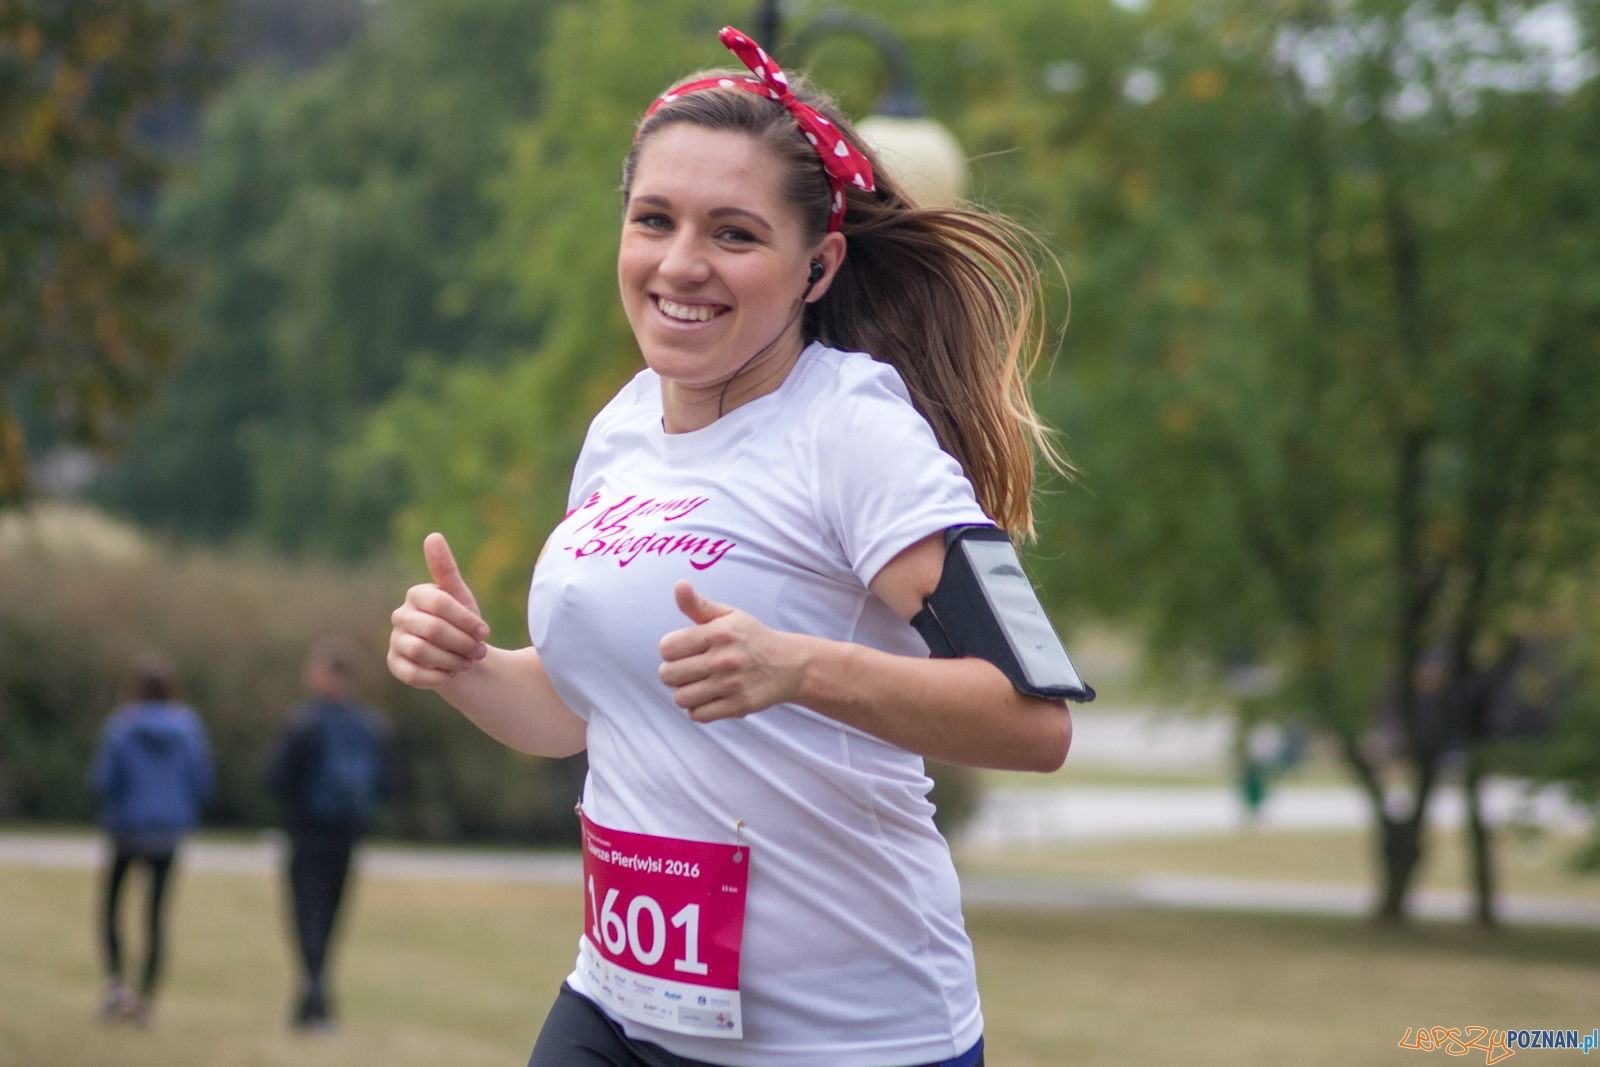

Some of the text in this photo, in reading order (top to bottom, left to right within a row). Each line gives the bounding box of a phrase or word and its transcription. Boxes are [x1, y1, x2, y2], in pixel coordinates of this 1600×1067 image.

[572, 495, 710, 535] Mamy
[611, 850, 663, 874] Pier(w)si
[665, 859, 700, 878] 2016
[588, 873, 709, 976] 1601
